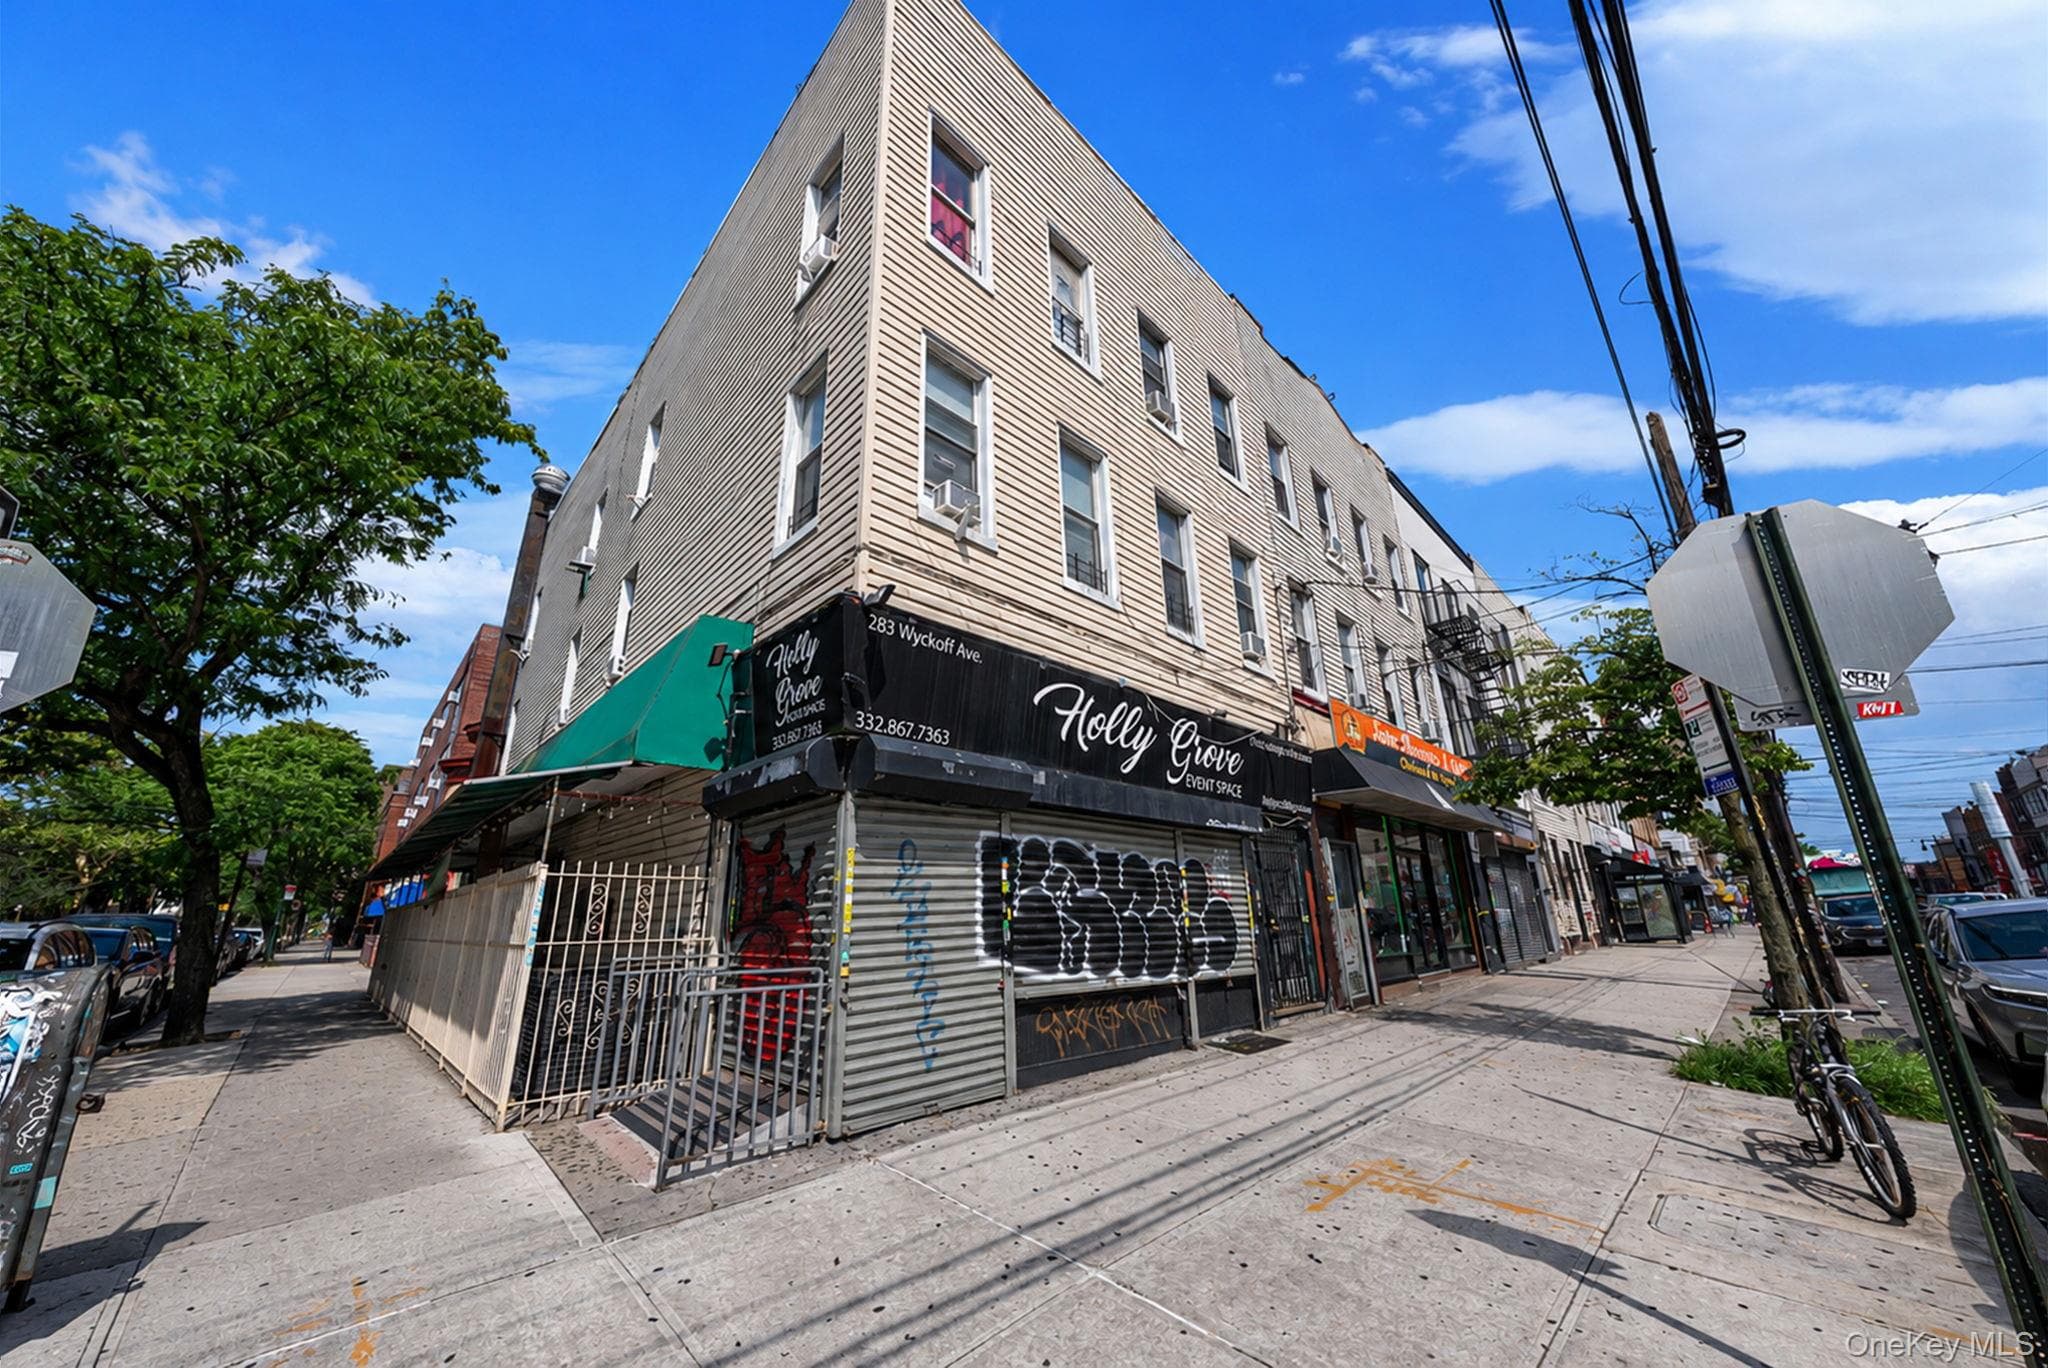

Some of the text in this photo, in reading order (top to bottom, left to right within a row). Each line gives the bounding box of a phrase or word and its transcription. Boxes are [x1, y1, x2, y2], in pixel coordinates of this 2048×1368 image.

[766, 629, 820, 678] Holly
[868, 613, 982, 664] 283 Wyckoff Ave.
[775, 675, 823, 728] Grove
[855, 711, 950, 745] 332.867.7363
[1032, 682, 1244, 785] Holly Grove
[1186, 775, 1243, 799] EVENT SPACE
